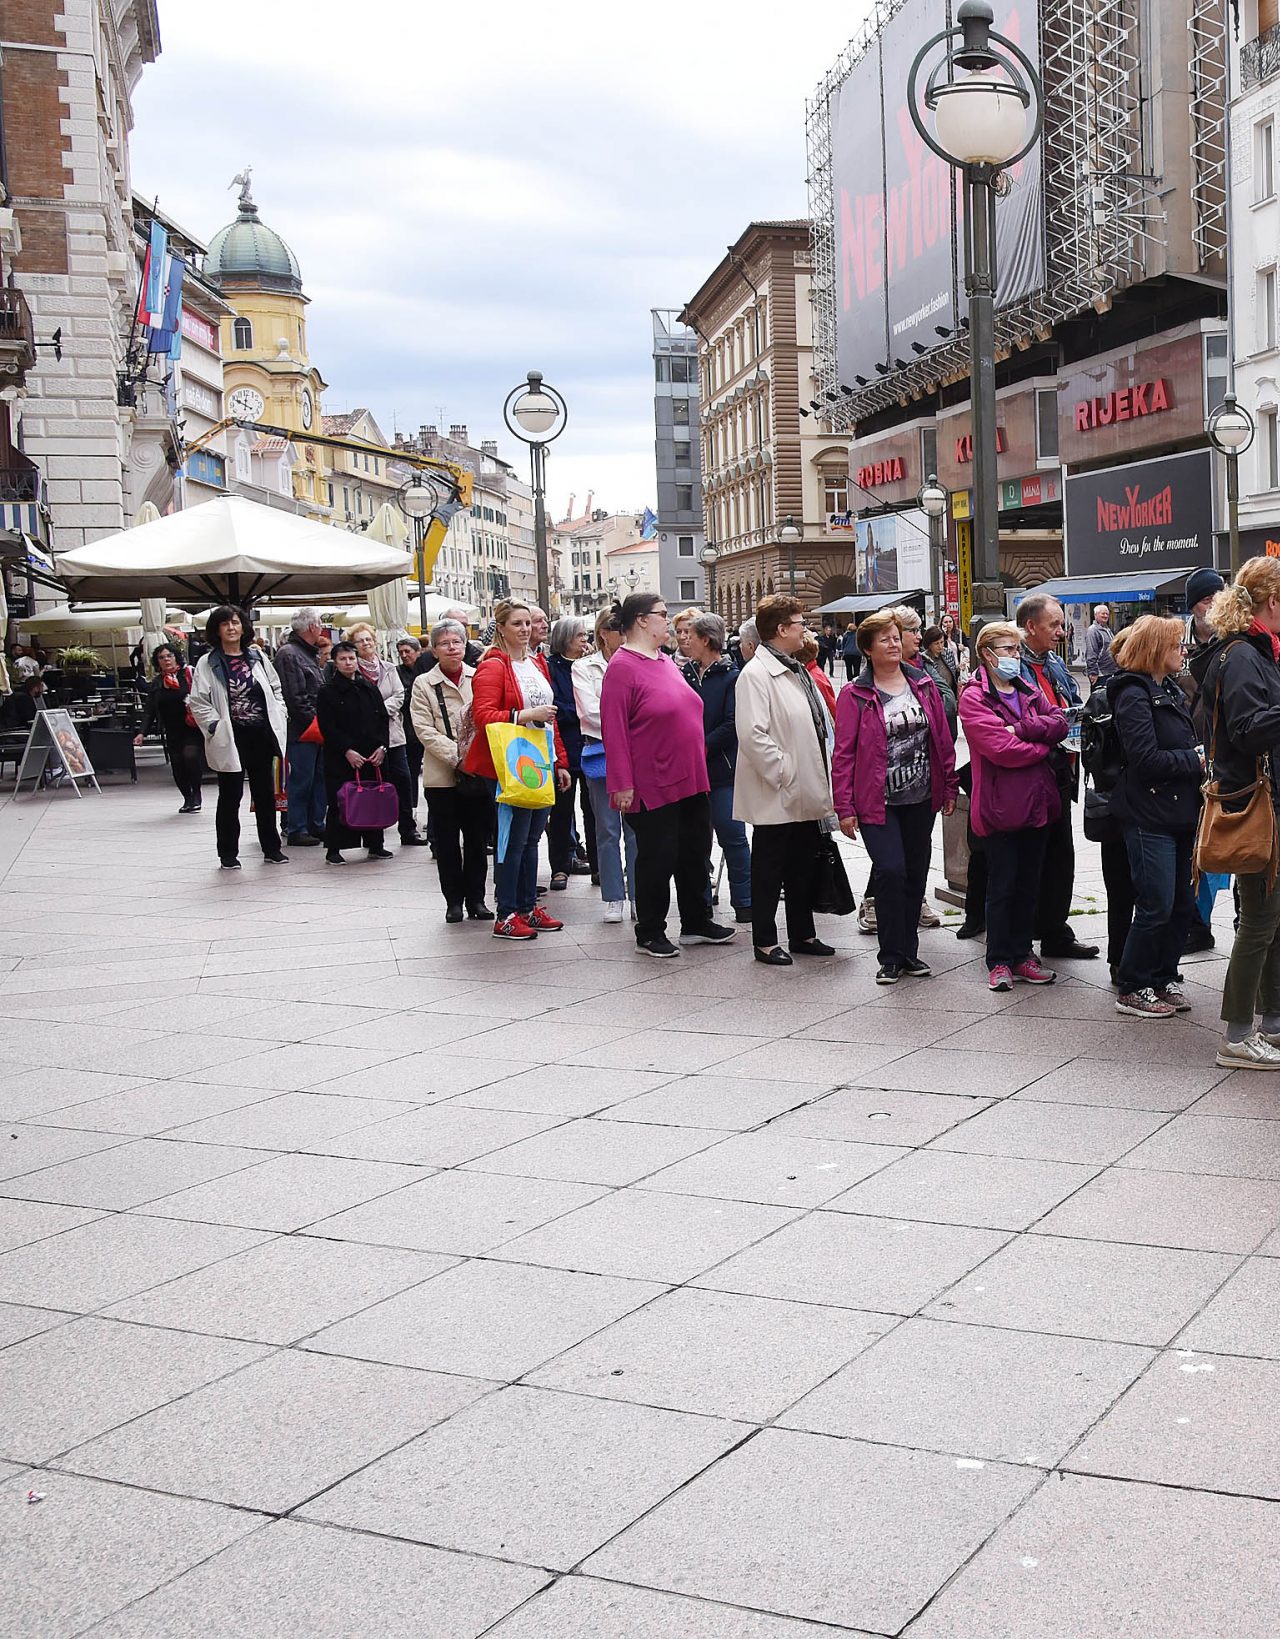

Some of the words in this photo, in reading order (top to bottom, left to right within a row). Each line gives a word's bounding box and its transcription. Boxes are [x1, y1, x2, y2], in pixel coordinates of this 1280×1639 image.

[1074, 378, 1174, 432] RIJEKA
[856, 457, 907, 489] ROBNA
[1120, 537, 1139, 554] Dress
[1139, 535, 1151, 558] for
[1153, 535, 1165, 552] the
[1166, 534, 1199, 550] moment.
